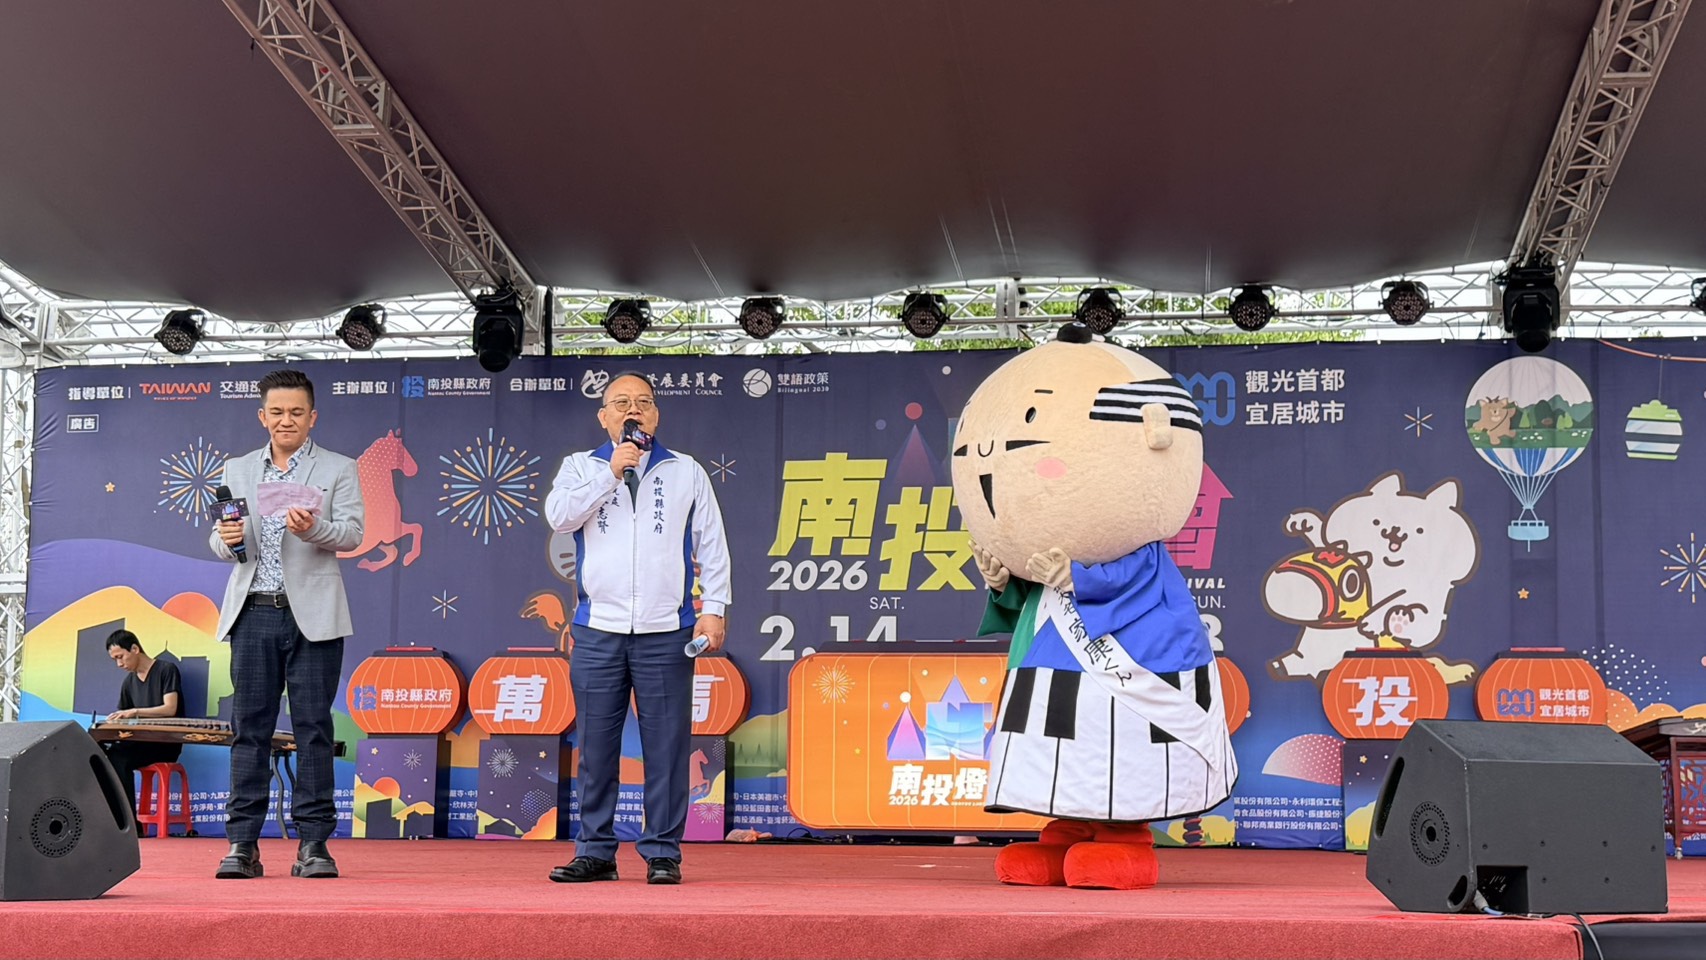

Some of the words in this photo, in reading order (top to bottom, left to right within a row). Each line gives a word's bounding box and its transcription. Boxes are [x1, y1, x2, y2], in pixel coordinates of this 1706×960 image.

[427, 377, 491, 390] 南投縣政府
[509, 378, 567, 391] 合辦單位
[777, 372, 829, 385] 雙語政策
[1245, 369, 1345, 393] 觀光首都
[68, 386, 124, 400] 指導單位
[139, 382, 211, 394] TAIWAN
[332, 381, 388, 395] 主辦單位
[1245, 400, 1345, 425] 宜居城市
[70, 417, 96, 431] 廣告
[766, 560, 868, 591] 2026
[1187, 578, 1226, 589] IVAL
[869, 597, 905, 610] SAT.
[381, 688, 453, 702] 南投縣政府
[474, 674, 549, 723] 萬
[1539, 688, 1591, 701] 觀光首都
[1342, 676, 1419, 727] 投
[1540, 704, 1591, 717] 宜居城市
[889, 795, 919, 806] 2026
